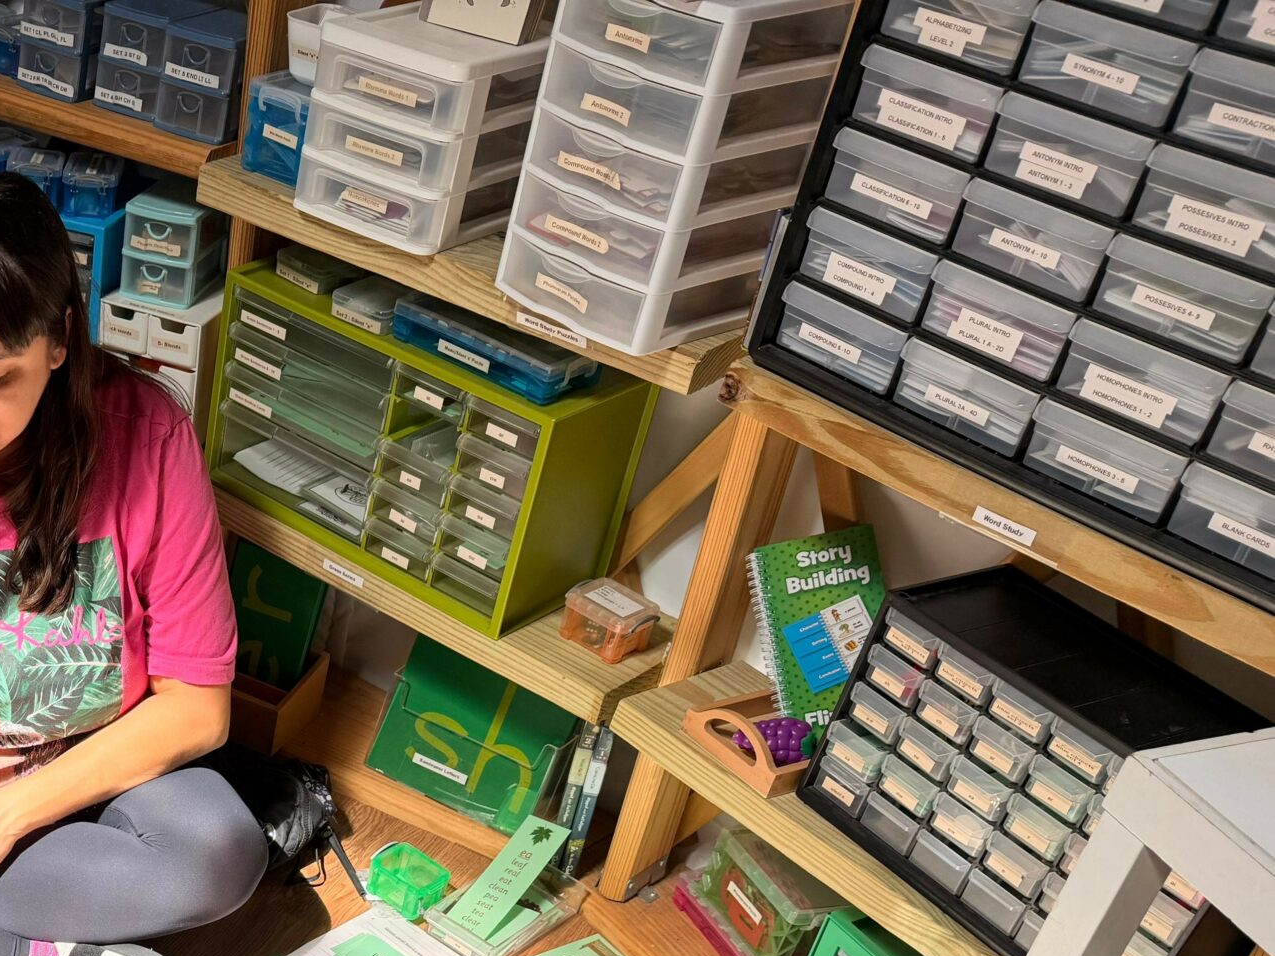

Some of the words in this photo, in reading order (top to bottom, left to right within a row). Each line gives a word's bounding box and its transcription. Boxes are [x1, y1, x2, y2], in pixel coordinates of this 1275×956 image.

[925, 16, 972, 35] ALPHABETIZING
[929, 34, 948, 47] LEVEL
[949, 39, 954, 48] 2
[171, 67, 181, 77] SET
[1073, 62, 1105, 79] SYNONYM
[889, 97, 934, 119] CLASSIFICATION
[934, 112, 953, 126] INTRO
[887, 115, 933, 137] CLASSIFICATION
[563, 157, 595, 174] Compound
[1031, 150, 1063, 167] ANTONYM
[1063, 161, 1084, 174] INTRO
[1028, 168, 1058, 186] ANTONYM
[861, 182, 905, 205] CLASSIFICATION
[1182, 204, 1227, 224] POSSESIVES
[1227, 218, 1250, 231] INTRO
[551, 221, 582, 240] Compound
[582, 233, 597, 247] Words
[1178, 222, 1223, 242] POSSESIVES
[1001, 237, 1031, 255] ANTONYM
[837, 260, 868, 280] COMPOUND
[867, 271, 885, 285] INTRO
[833, 274, 863, 293] COMPOUND
[1144, 293, 1188, 314] POSSESIVES
[524, 318, 539, 327] Word
[539, 323, 556, 335] Study
[557, 328, 579, 343] Puzzles
[968, 316, 992, 332] PLURAL
[992, 326, 1011, 338] INTRO
[808, 331, 837, 350] COMPOUND
[958, 329, 981, 345] PLURAL
[1097, 373, 1143, 397] HOMOPHONES
[1143, 391, 1164, 405] INTRO
[934, 392, 957, 409] PLURAL
[1092, 389, 1138, 412] HOMOPHONES
[1067, 453, 1112, 478] HOMOPHONES
[983, 513, 1002, 527] Word
[1002, 521, 1024, 538] Study
[1221, 522, 1246, 538] BLANK
[1246, 532, 1271, 549] CARDS
[796, 544, 853, 568] Story
[785, 565, 871, 595] Building
[443, 767, 461, 780] Letters
[504, 867, 522, 878] real
[511, 858, 529, 870] leaf
[488, 882, 509, 896] clean
[498, 876, 512, 886] eat
[476, 900, 494, 911] seat
[483, 892, 499, 903] pea
[461, 914, 481, 927] clear
[471, 908, 485, 918] tea
